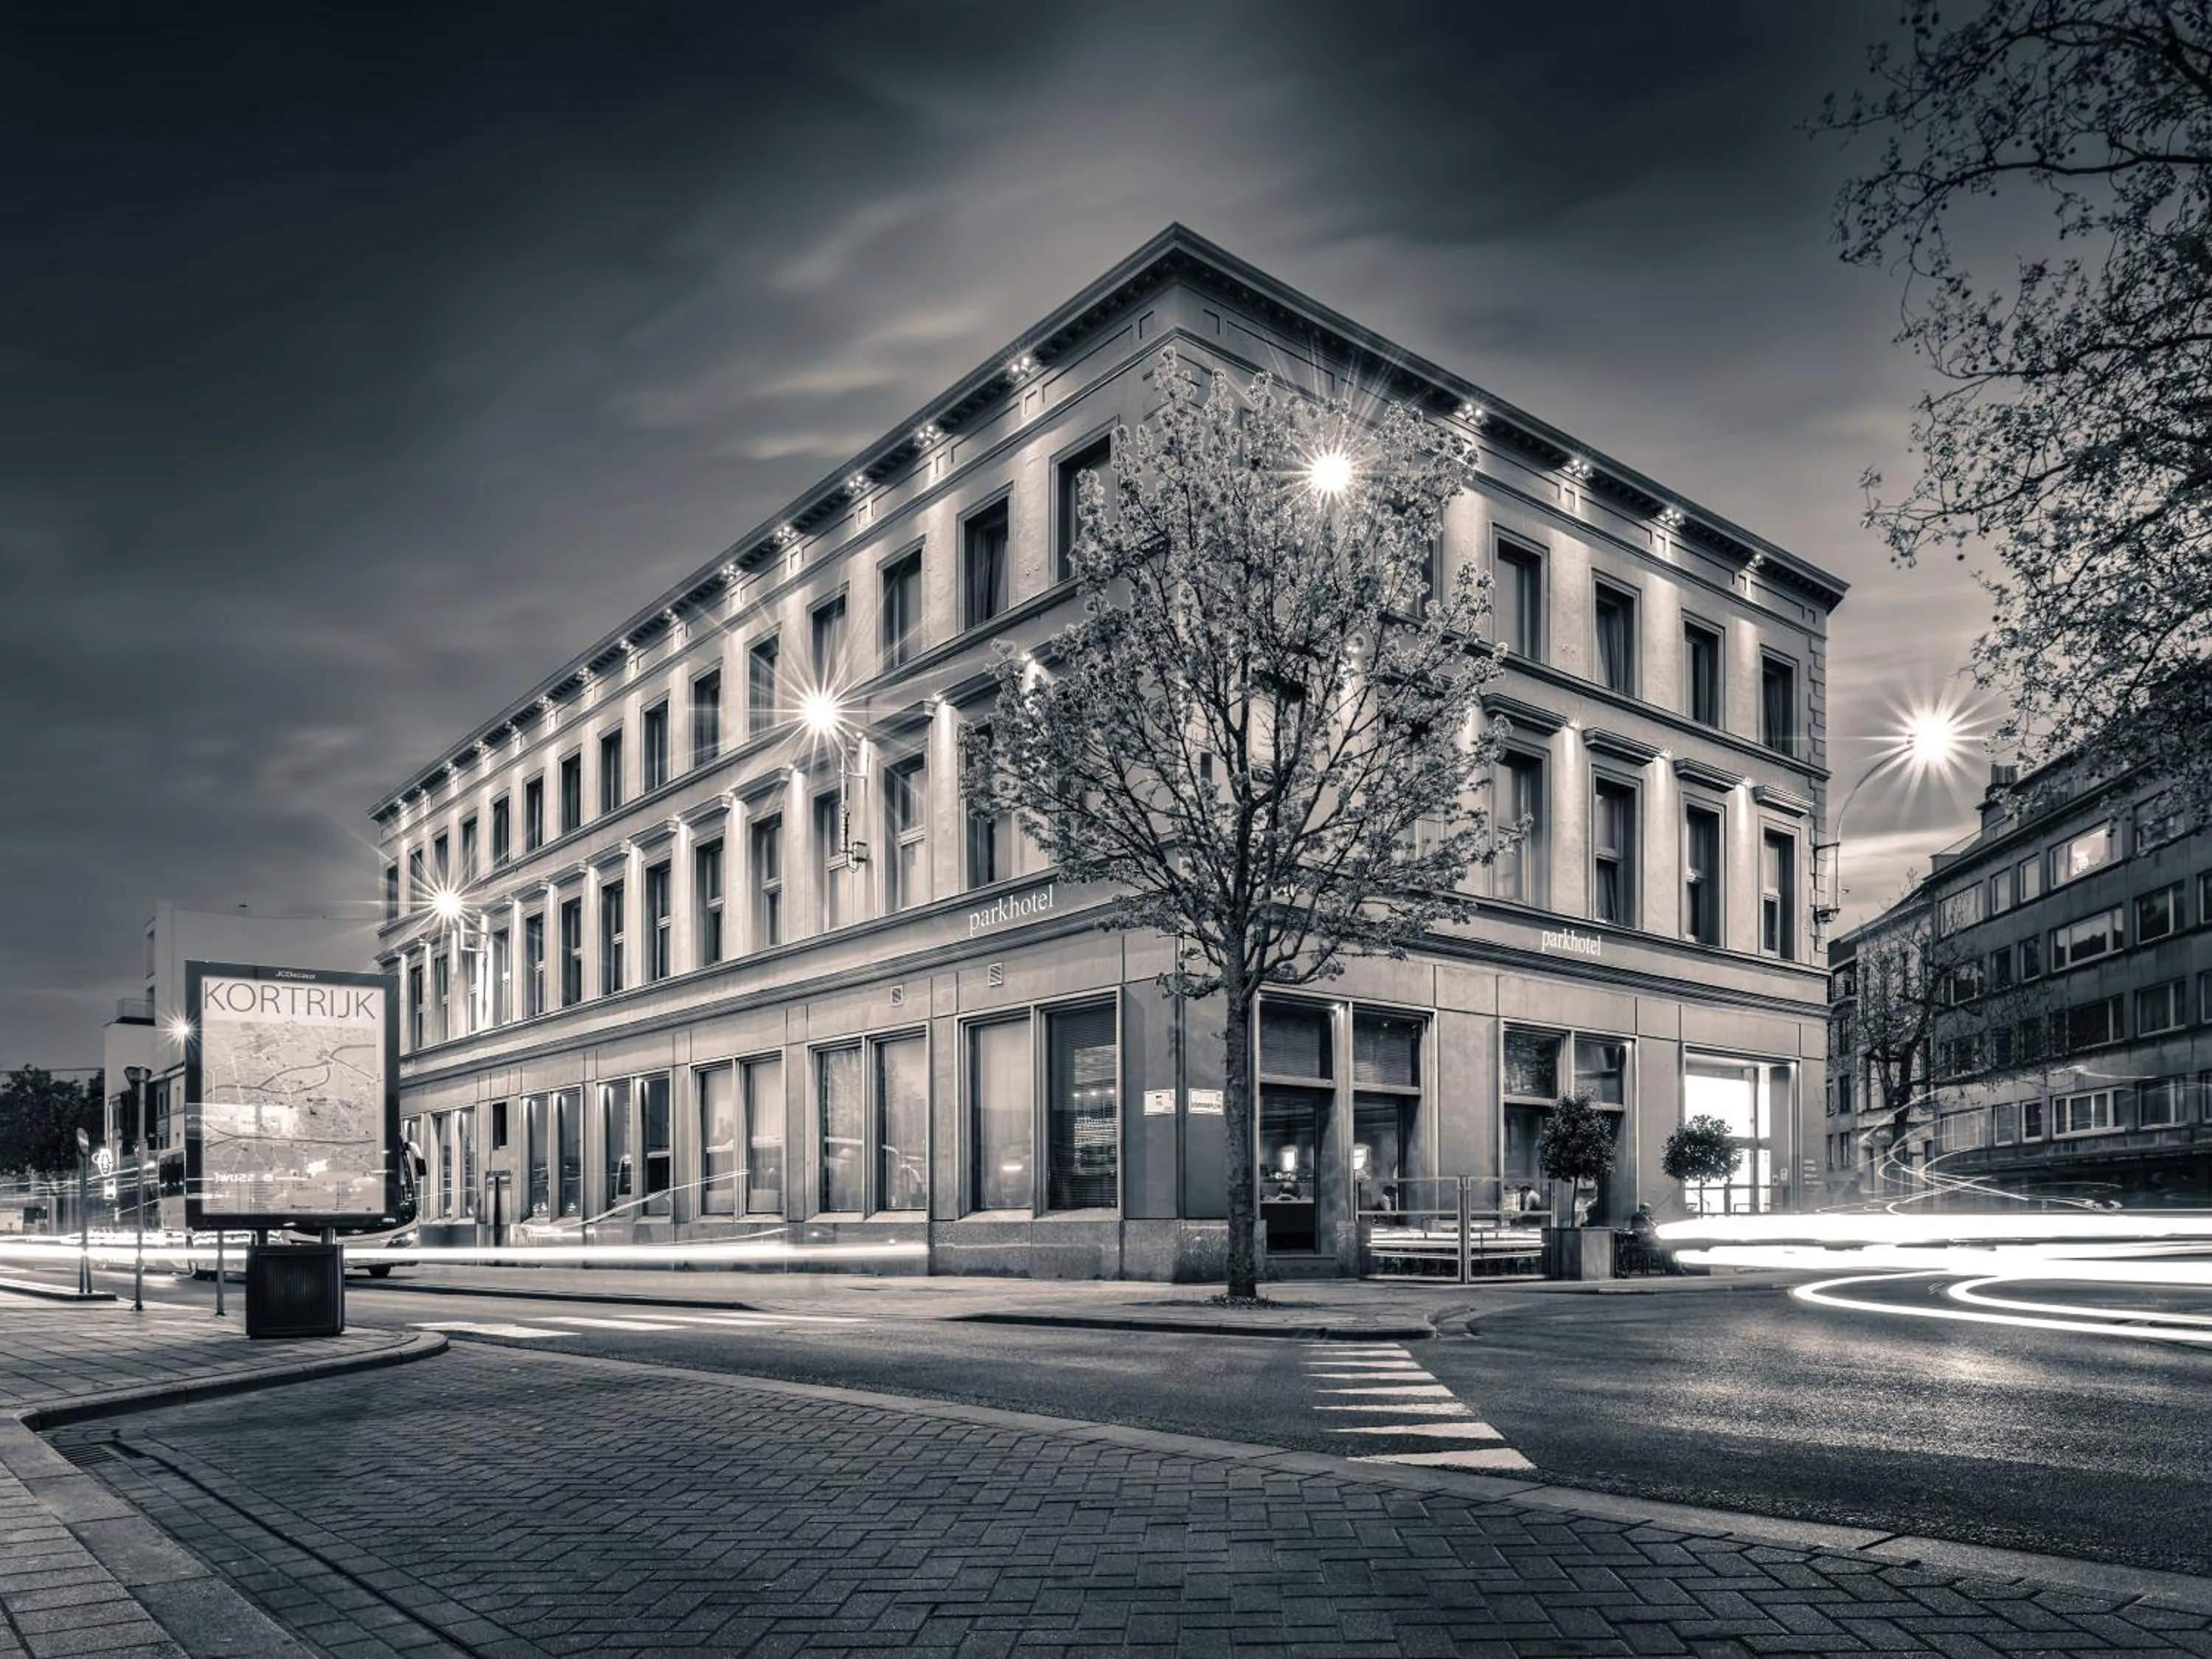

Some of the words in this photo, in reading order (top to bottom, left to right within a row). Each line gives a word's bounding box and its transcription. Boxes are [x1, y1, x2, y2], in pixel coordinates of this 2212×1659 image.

[969, 884, 1053, 937] parkhotel
[1542, 928, 1601, 956] parkhotel
[204, 981, 376, 1020] KORTRIJK
